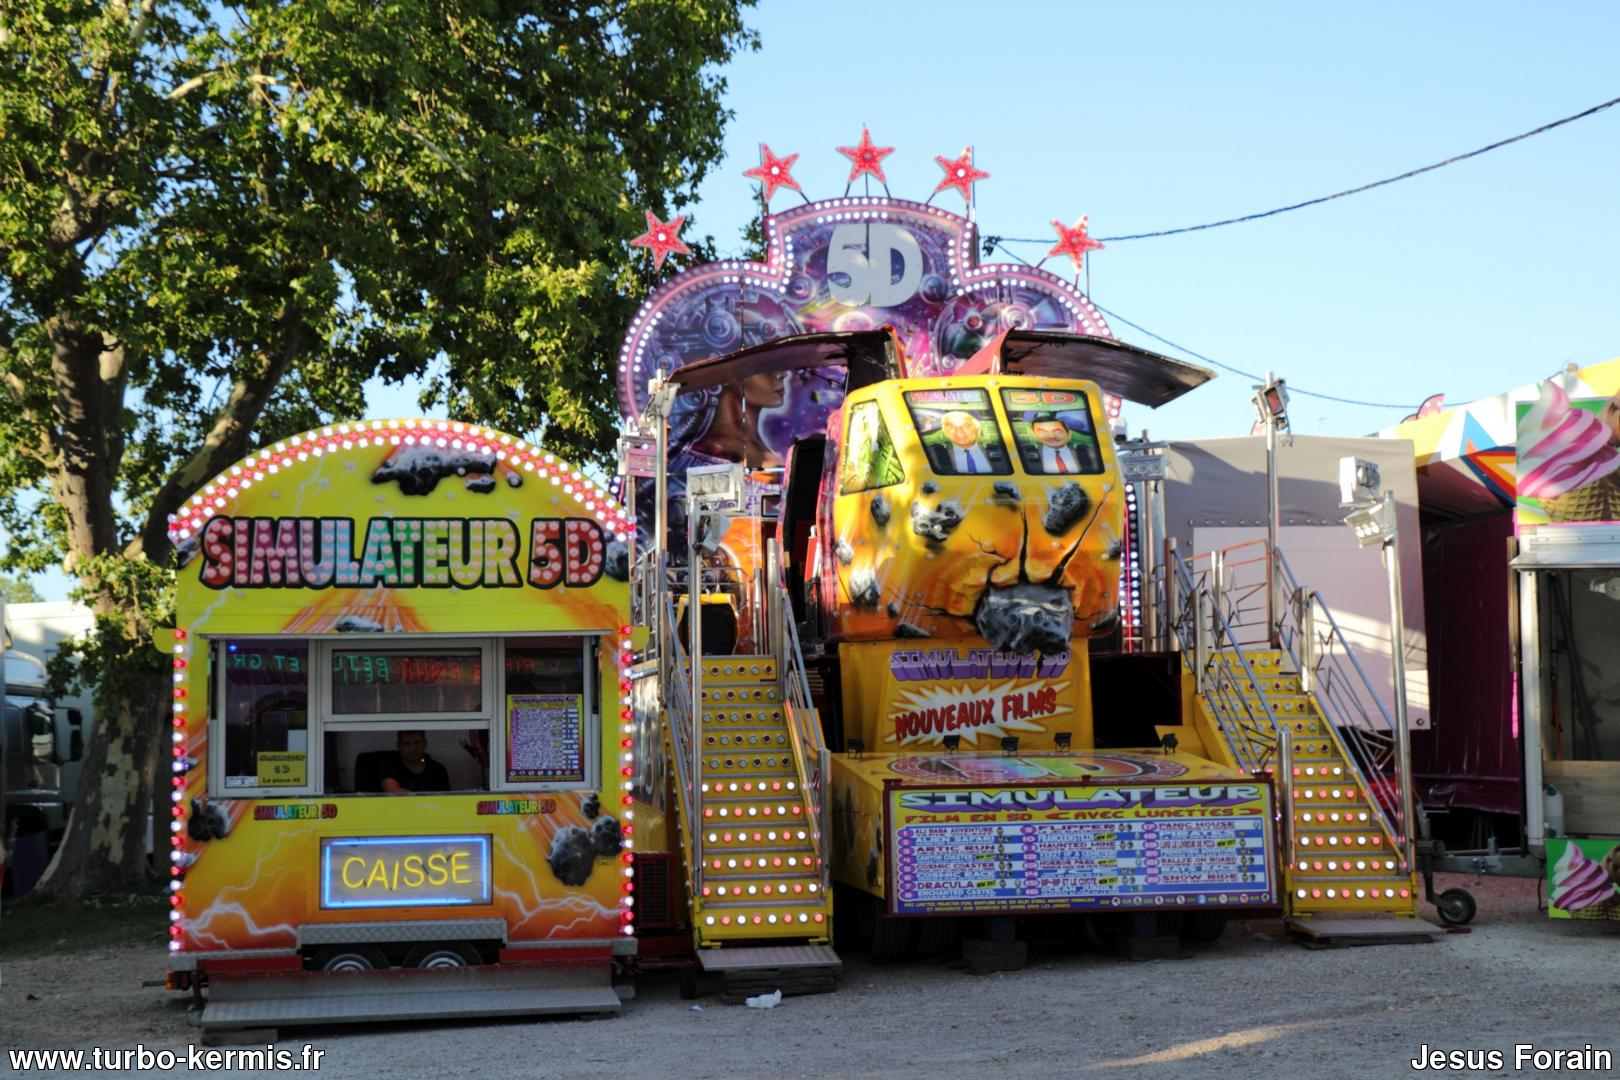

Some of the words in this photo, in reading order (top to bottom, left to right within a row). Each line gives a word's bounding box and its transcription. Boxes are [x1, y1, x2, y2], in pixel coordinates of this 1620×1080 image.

[827, 222, 923, 307] 5D
[1009, 391, 1076, 405] 5D
[201, 516, 522, 588] SIMULATEUR
[527, 517, 606, 588] 5D
[890, 649, 1037, 680] SIMULATEUR
[895, 699, 995, 740] NOUVEAUX
[1001, 687, 1057, 722] FILMS
[254, 805, 318, 820] SIMULATEUR
[321, 804, 338, 819] 5D
[476, 800, 540, 815] SIMULATEUR
[540, 800, 556, 815] 5D
[899, 786, 1262, 812] SIMULATEUR
[970, 814, 996, 822] EN
[342, 852, 471, 891] CAISSE
[918, 881, 974, 890] DRACULA
